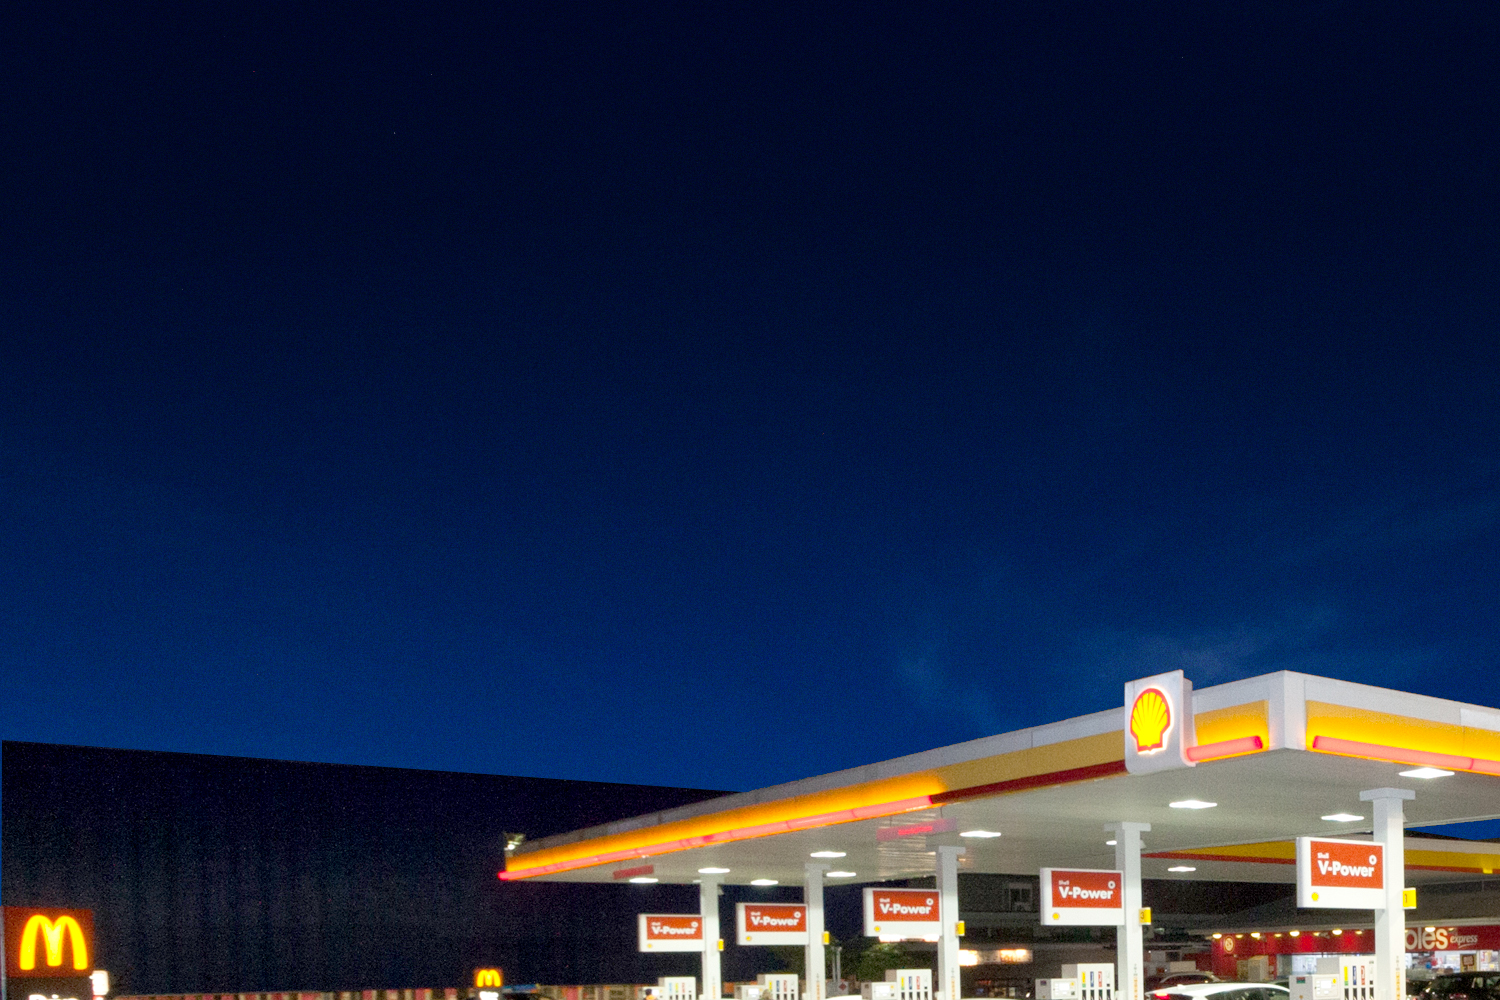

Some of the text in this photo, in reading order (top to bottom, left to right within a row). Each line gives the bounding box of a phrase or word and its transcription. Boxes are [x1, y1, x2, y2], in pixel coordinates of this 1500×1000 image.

[1317, 860, 1375, 877] V-Power
[1058, 886, 1114, 899] V-Power
[880, 903, 932, 914] V-Power
[751, 916, 800, 926] V-Power
[651, 926, 697, 935] V-Power
[1405, 926, 1479, 950] oles express
